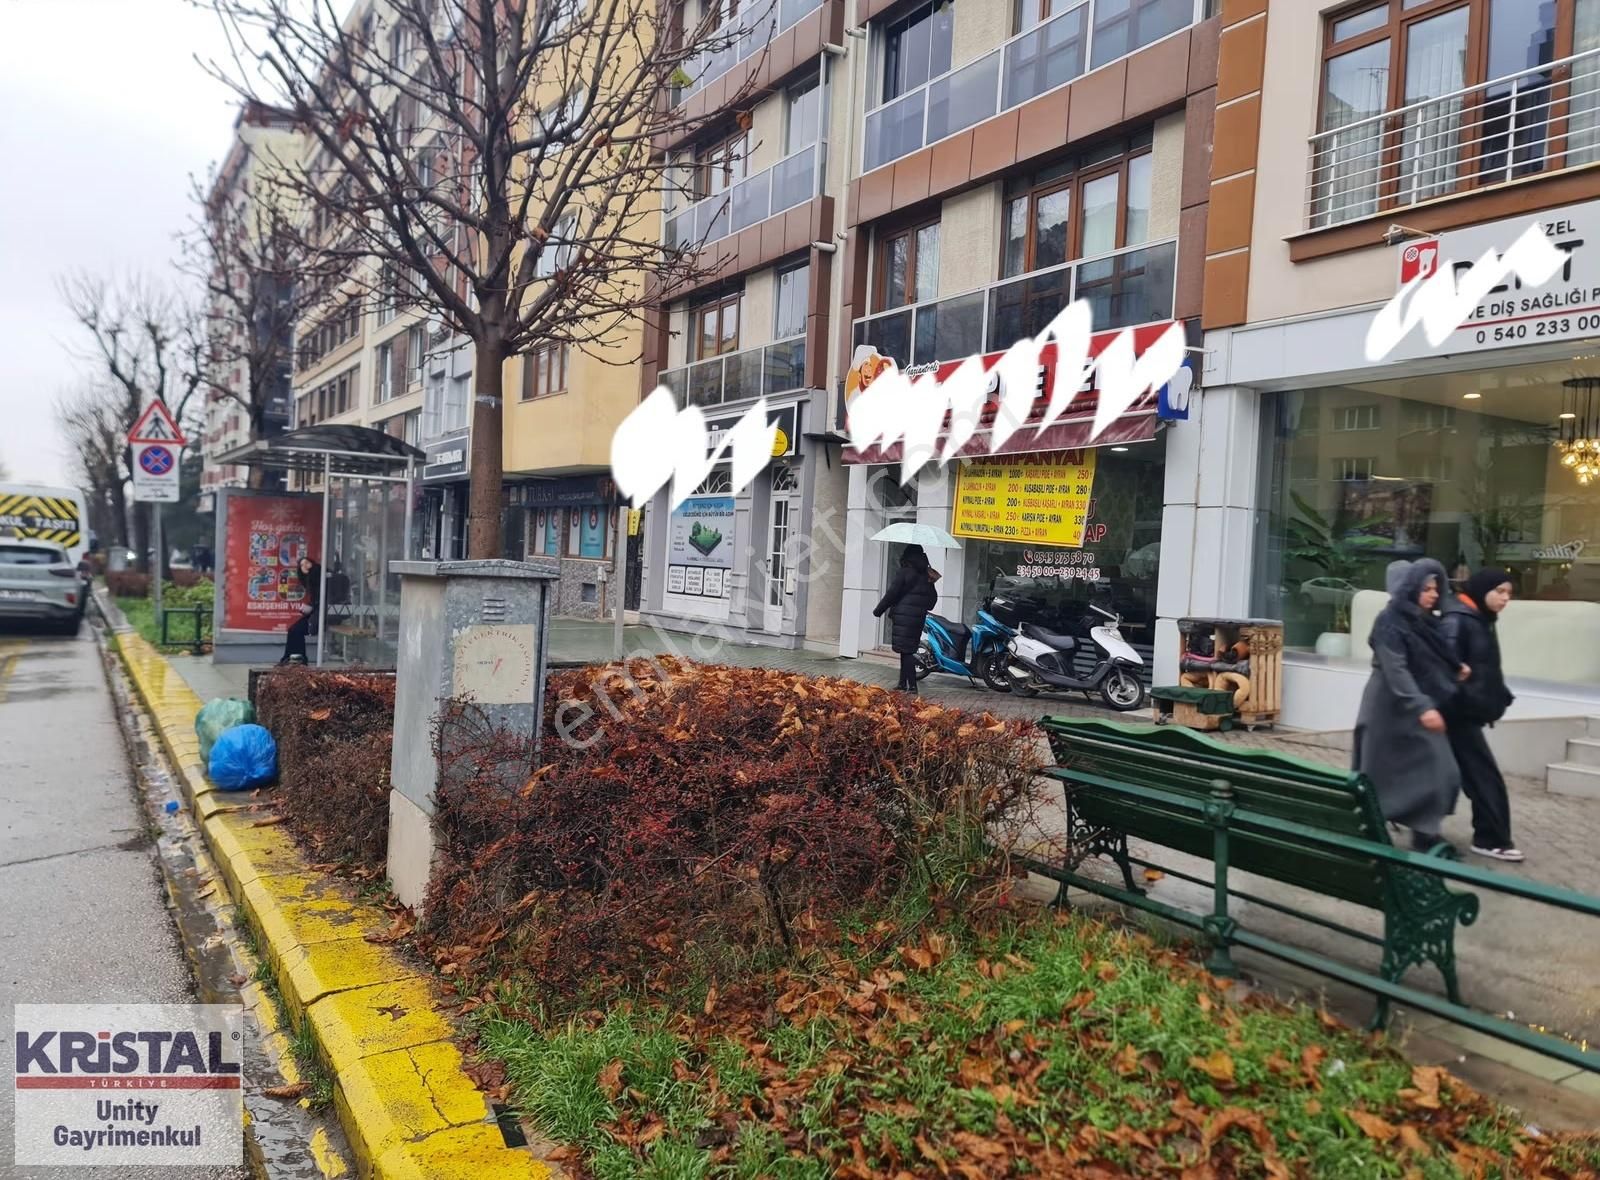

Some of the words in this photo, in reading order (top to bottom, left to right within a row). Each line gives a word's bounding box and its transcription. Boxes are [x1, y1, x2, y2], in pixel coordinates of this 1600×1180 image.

[1545, 219, 1576, 237] ZEL
[1490, 299, 1515, 317] DİŞ
[1520, 287, 1587, 312] SAĞLIĞI
[1476, 330, 1486, 344] 0
[1494, 324, 1527, 341] 540
[1535, 318, 1570, 336] 233
[1578, 314, 1600, 331] 00
[1085, 523, 1106, 542] AP
[1034, 552, 1053, 564] 0545
[1055, 552, 1070, 564] 975
[1071, 551, 1082, 564] 58
[1083, 553, 1095, 565] 70
[1017, 565, 1031, 578] 234
[1032, 566, 1042, 578] 50
[1076, 567, 1087, 580] 24
[1088, 568, 1100, 580] 45
